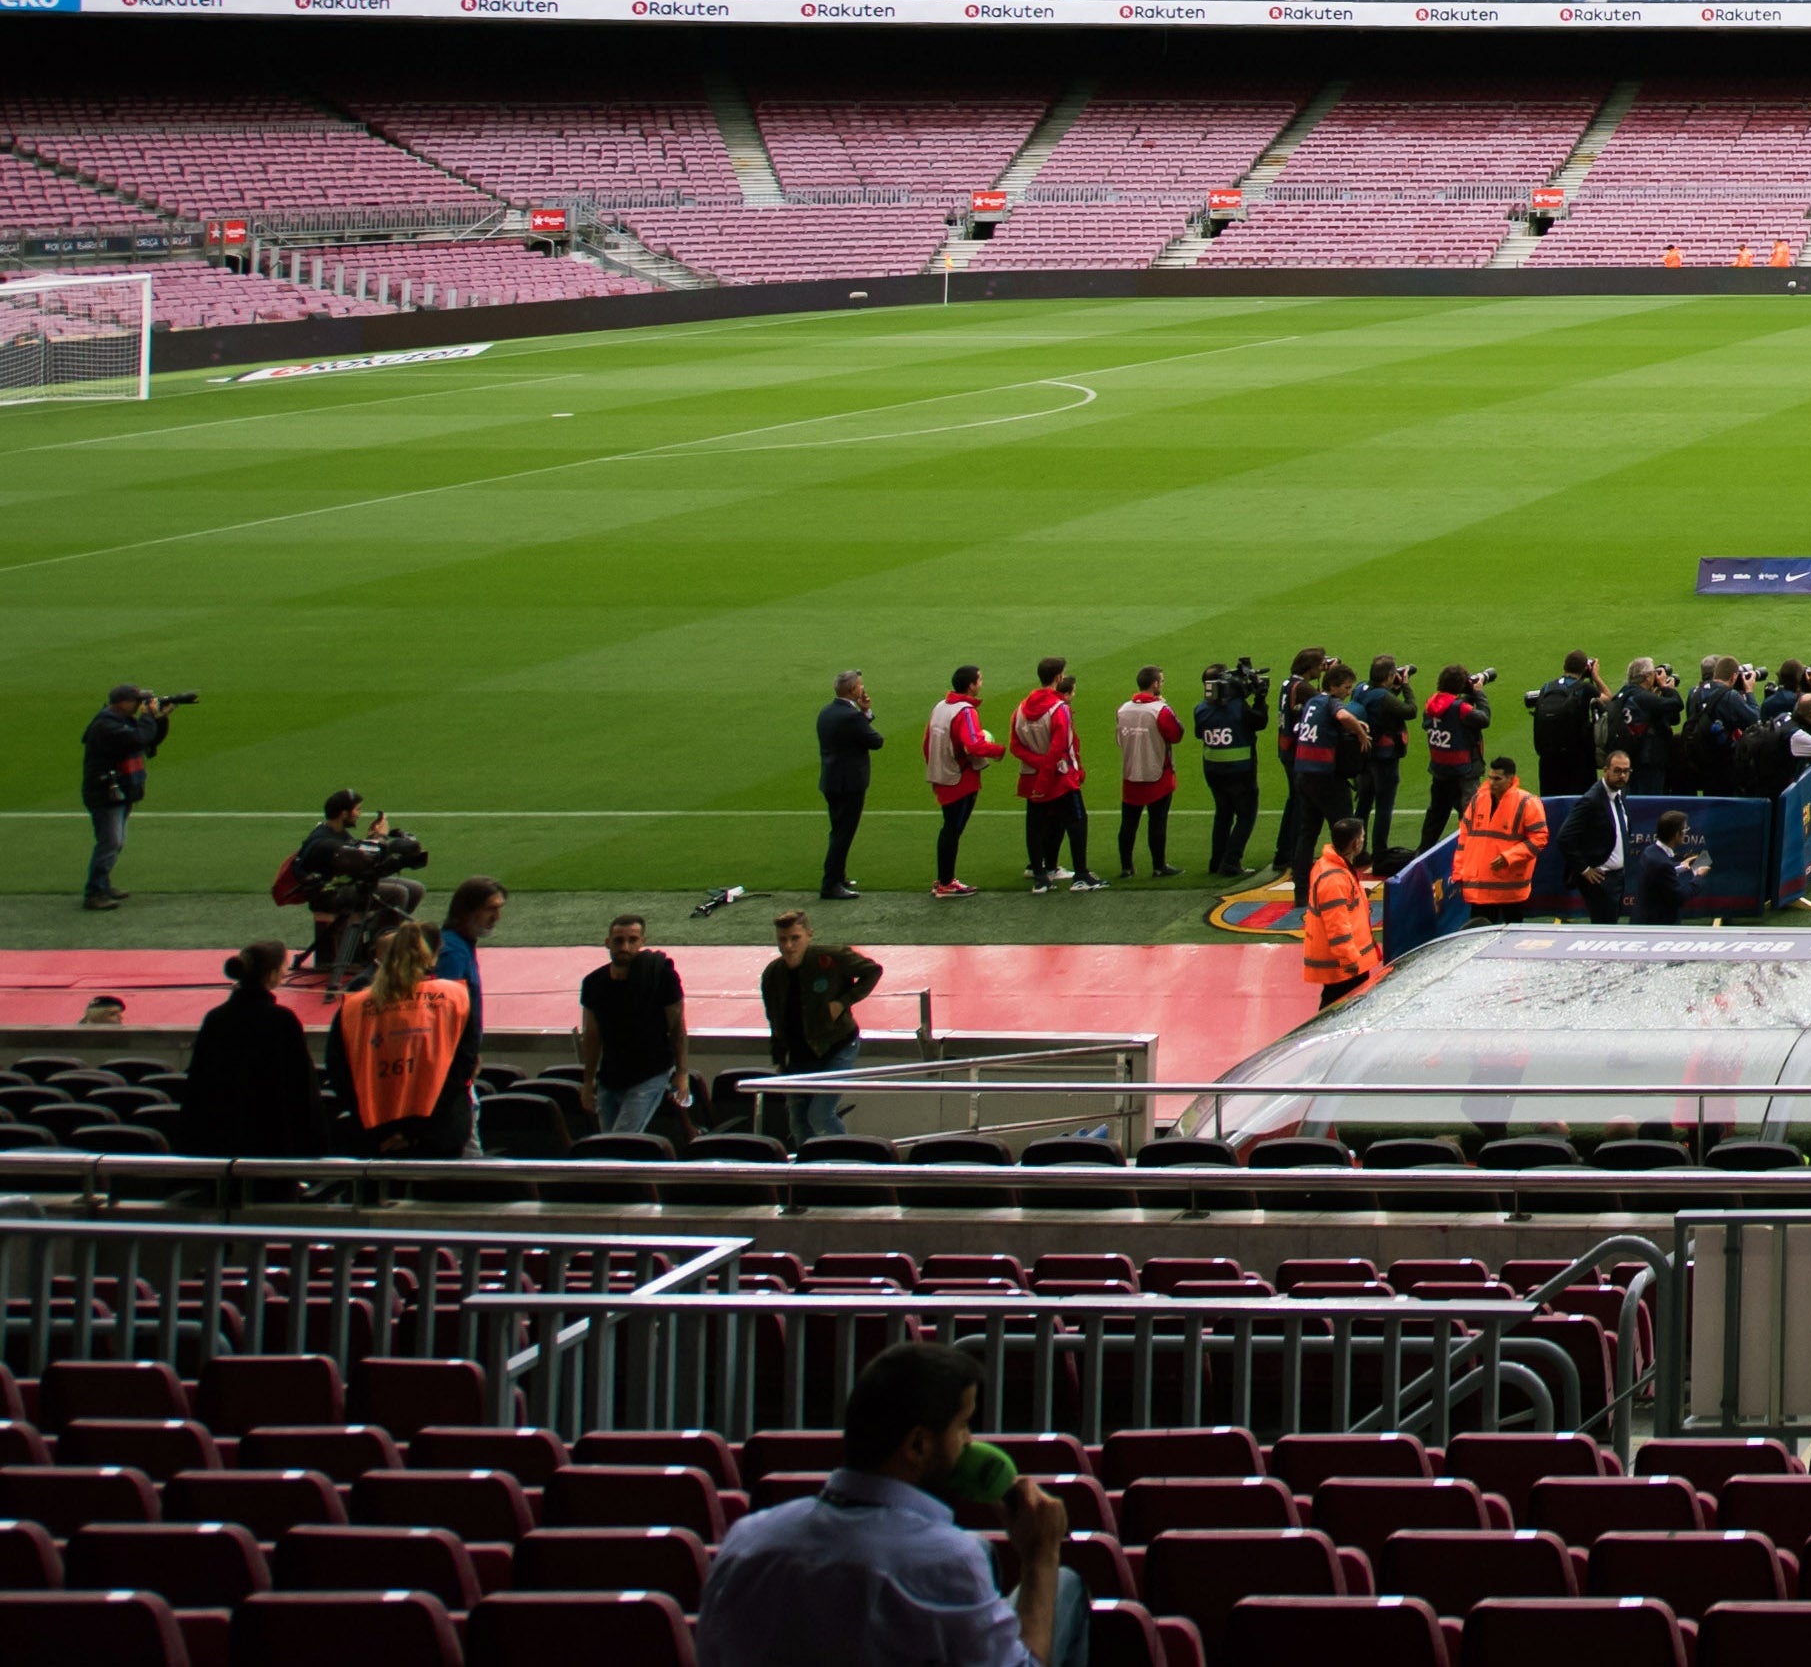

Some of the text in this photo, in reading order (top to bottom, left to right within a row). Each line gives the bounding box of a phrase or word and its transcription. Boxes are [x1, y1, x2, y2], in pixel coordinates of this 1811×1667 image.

[648, 1, 730, 16] Rakuten
[817, 3, 896, 18] Rakuten
[980, 4, 1055, 19] Rakuten
[1134, 5, 1206, 19] Rakuten
[1283, 6, 1353, 21] Rakuten
[1430, 7, 1499, 22] Rakuten
[1574, 7, 1642, 22] Rakuten
[1715, 8, 1782, 22] Rakuten
[1303, 705, 1317, 723] F
[1204, 727, 1233, 746] 056
[1427, 729, 1452, 748] 232
[1567, 939, 1796, 953] NIKE.COM/FCB
